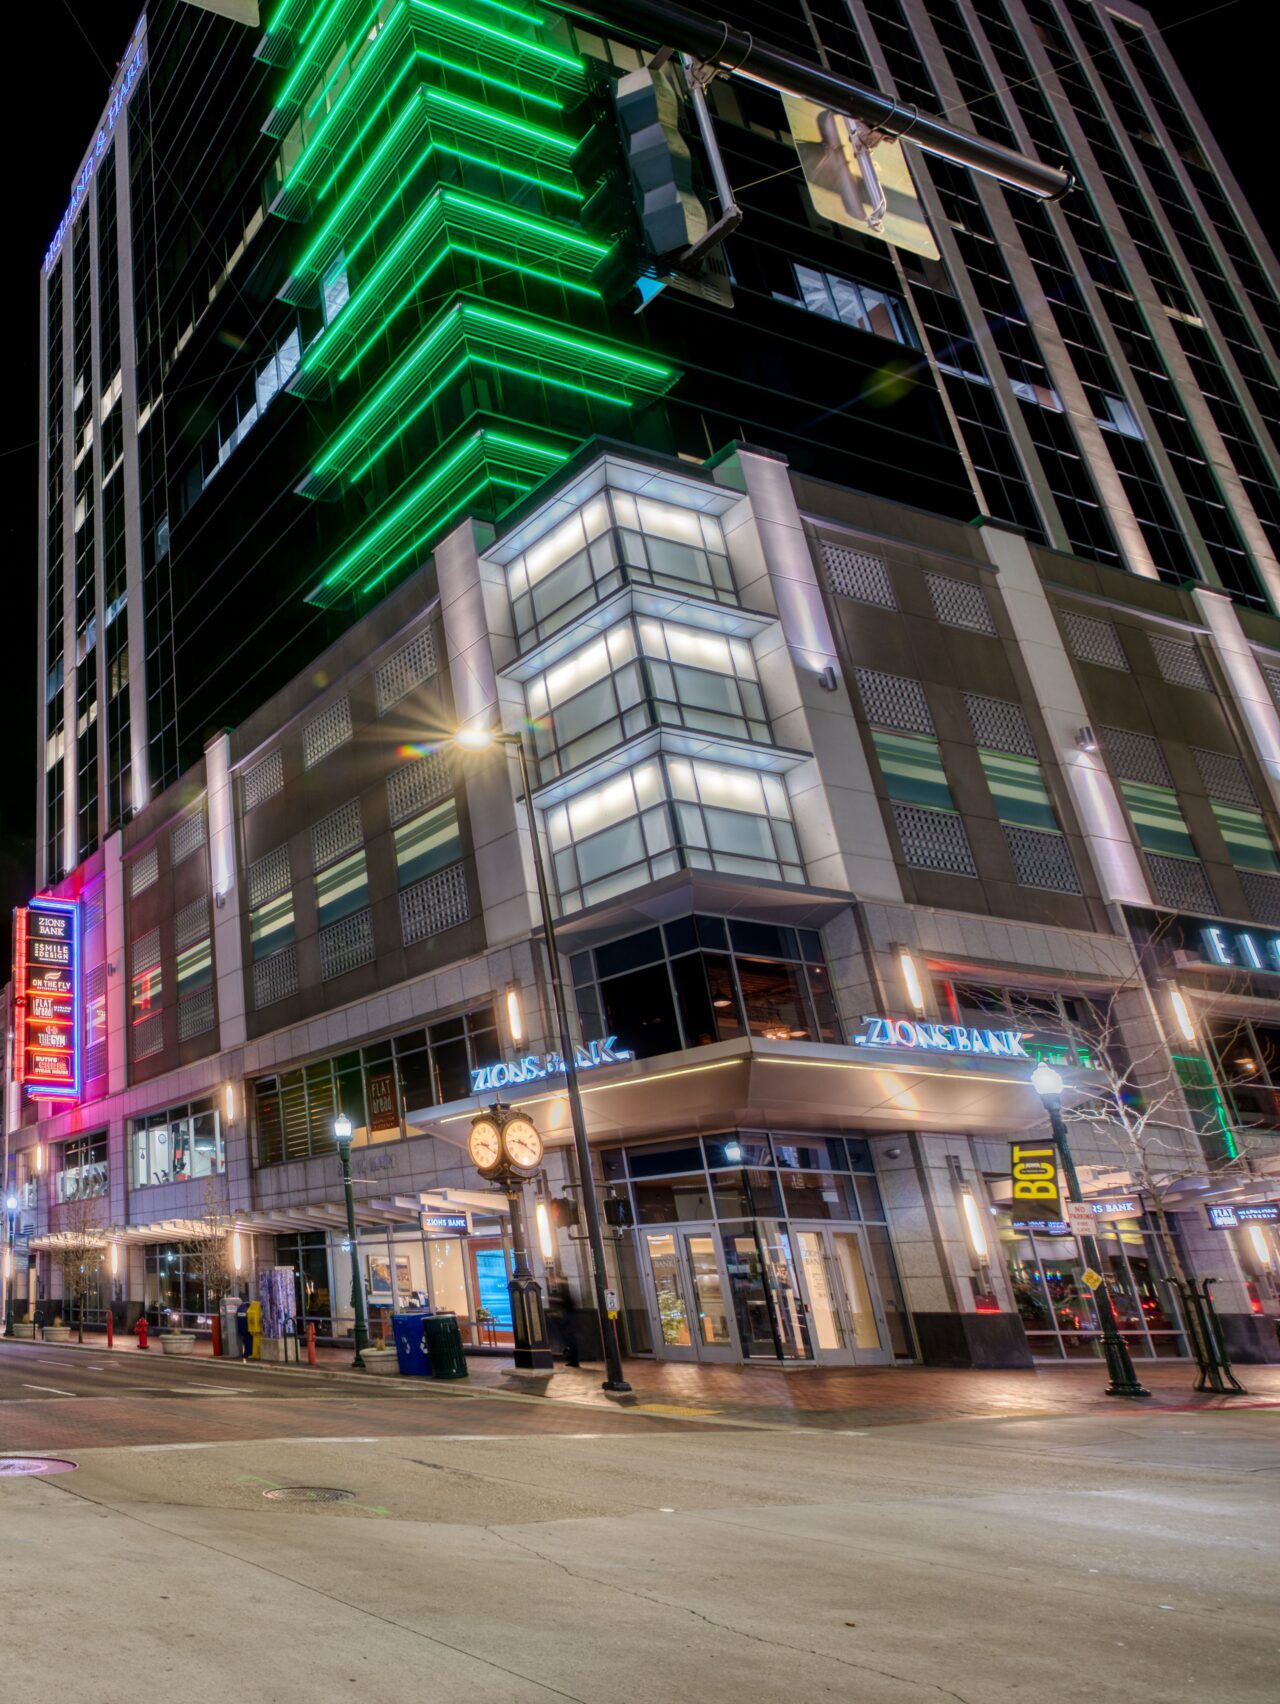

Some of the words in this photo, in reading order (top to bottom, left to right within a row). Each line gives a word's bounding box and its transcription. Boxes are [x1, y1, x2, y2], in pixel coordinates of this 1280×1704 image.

[45, 157, 94, 272] HOLLAND
[96, 130, 107, 156] &
[109, 43, 143, 129] HART
[39, 917, 65, 928] ZIONS
[40, 926, 64, 936] BANK
[40, 944, 68, 954] SMILE
[1201, 927, 1280, 970] EI
[39, 951, 68, 960] DESIGN
[32, 979, 42, 987] ON
[44, 980, 57, 988] THE
[58, 981, 71, 990] FLY
[35, 999, 52, 1008] FLAT
[863, 1018, 954, 1051] ZIONS
[954, 1026, 1029, 1057] BANK
[471, 1055, 541, 1091] ZIONS
[546, 1036, 619, 1074] BNK
[371, 1080, 390, 1098] FLAT
[1013, 1146, 1058, 1199] BCT
[1105, 1202, 1135, 1212] BANK
[1213, 1208, 1233, 1217] FLAT
[426, 1218, 447, 1226] ZIONS
[448, 1218, 466, 1227] BANK
